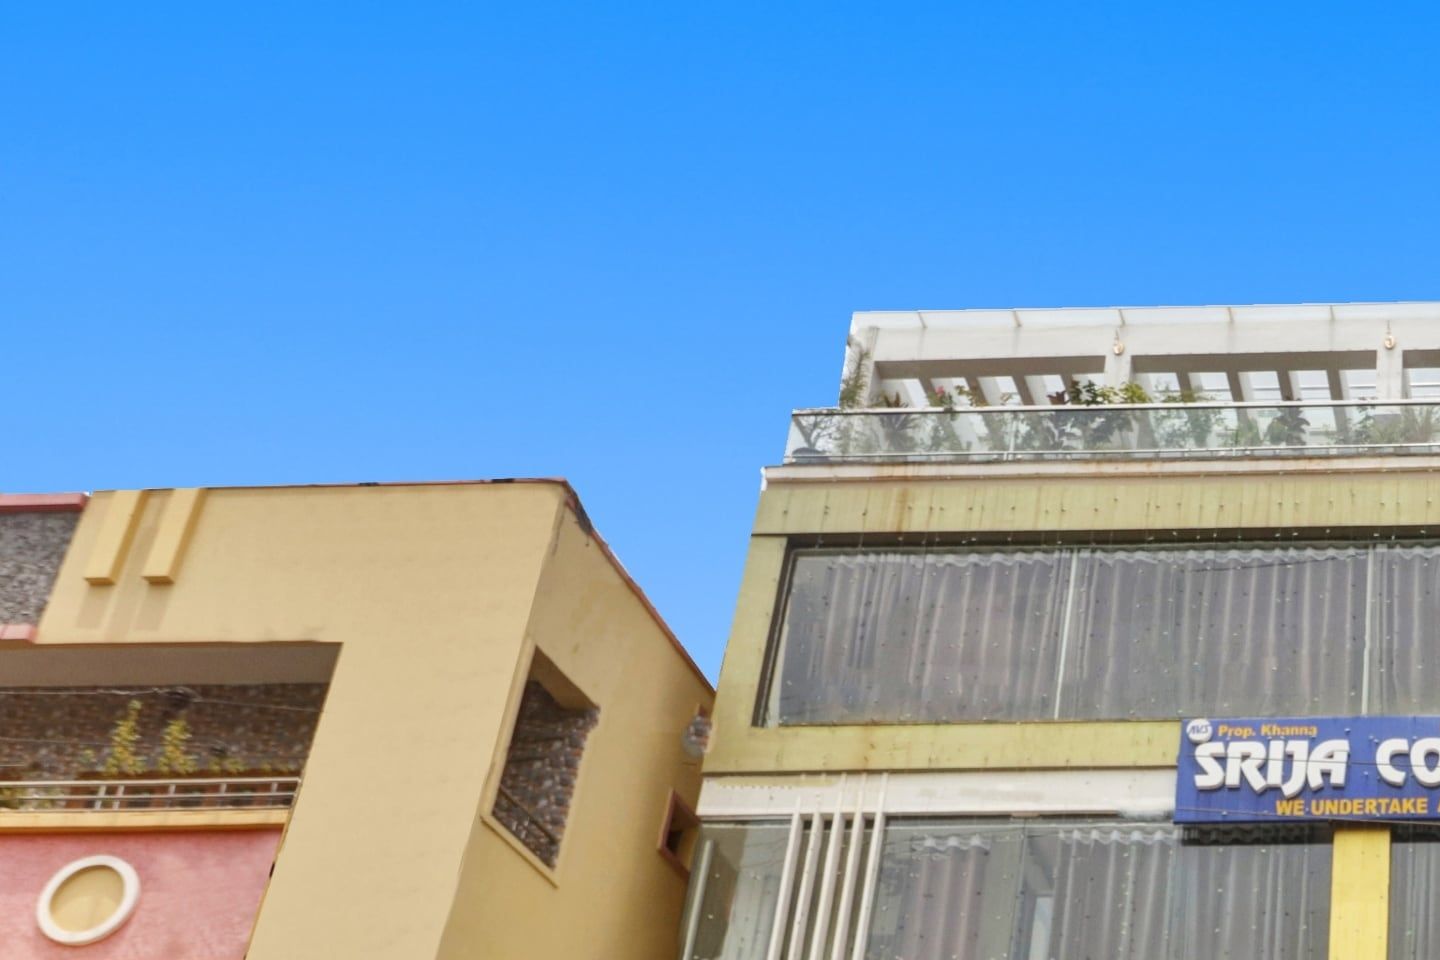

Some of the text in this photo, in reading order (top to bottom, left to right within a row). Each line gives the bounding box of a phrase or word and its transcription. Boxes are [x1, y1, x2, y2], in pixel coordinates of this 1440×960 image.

[1218, 724, 1318, 738] Prop. Khanna
[1194, 739, 1350, 799] SRIJA
[1276, 800, 1305, 816] WE
[1312, 797, 1428, 815] UNDERTAKE
